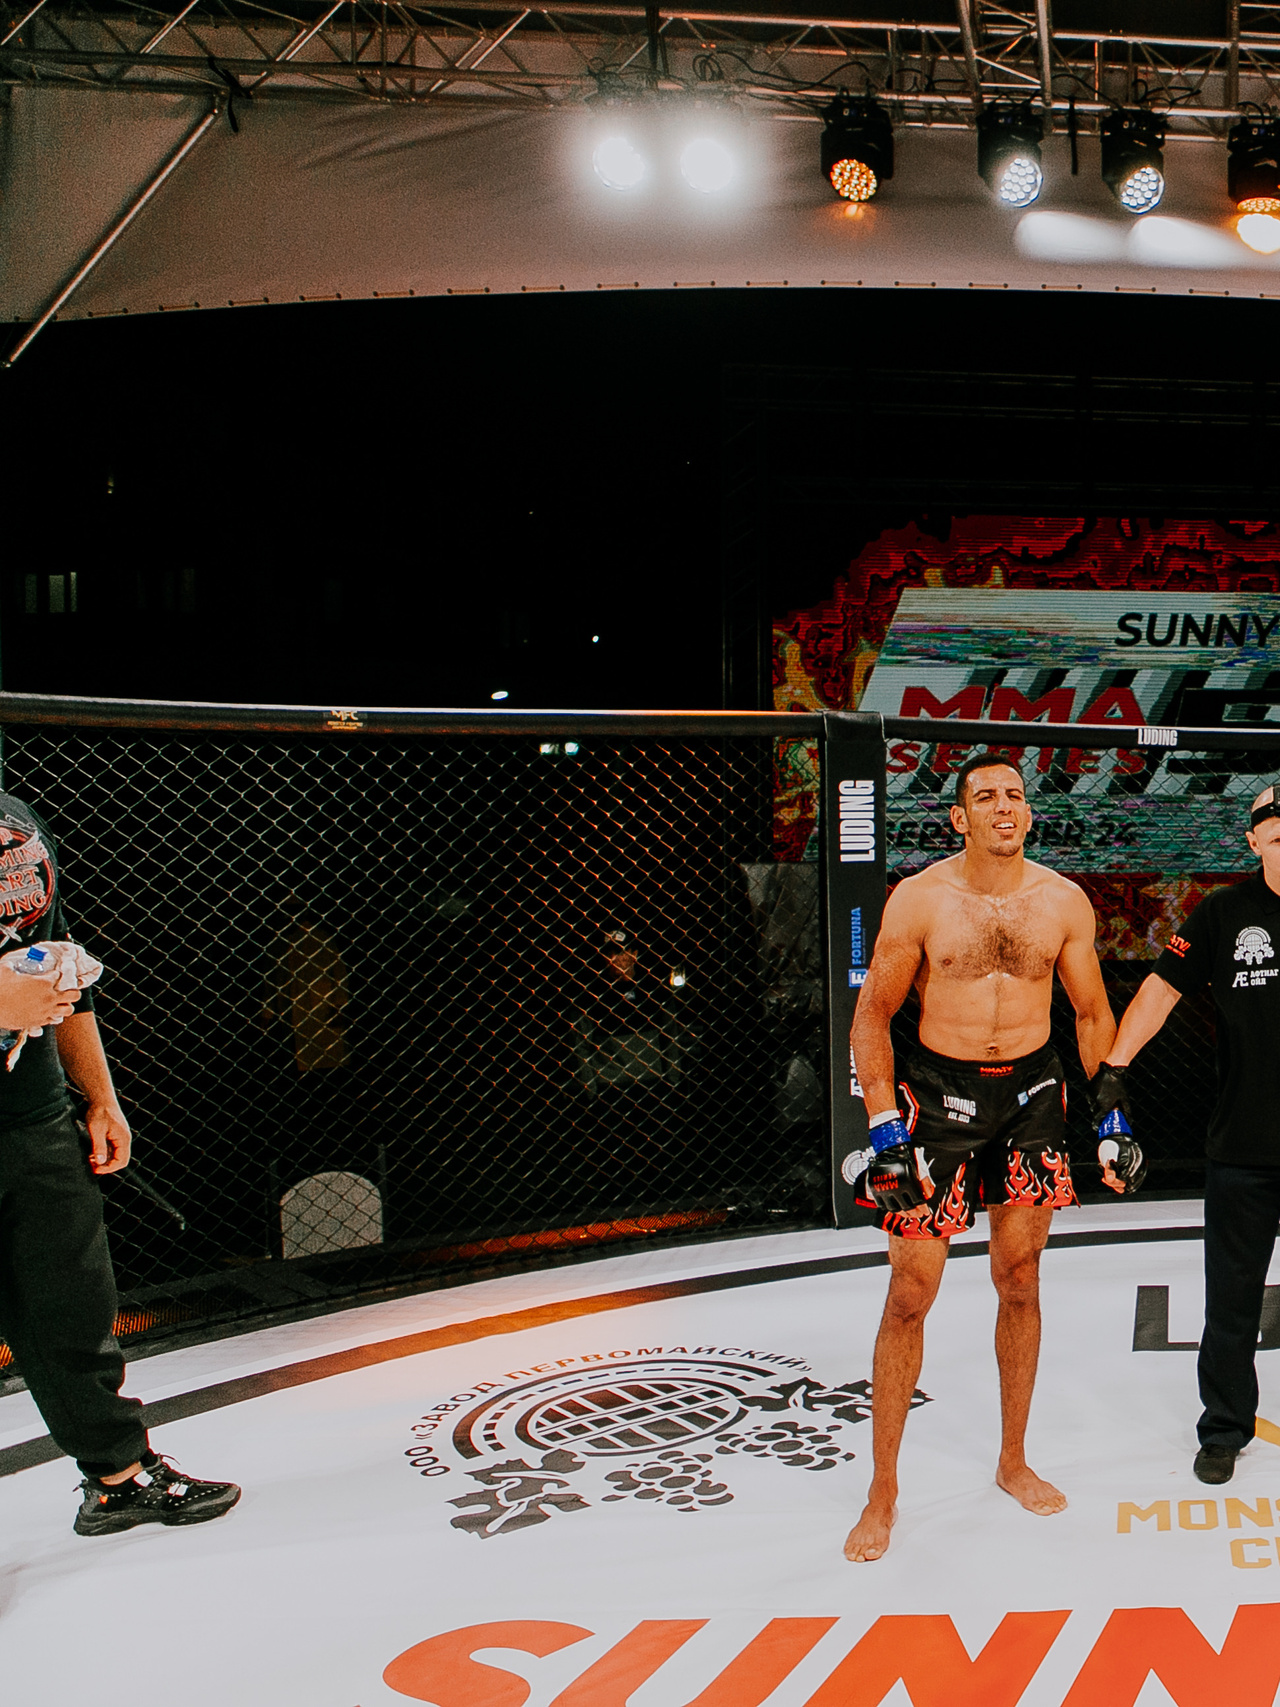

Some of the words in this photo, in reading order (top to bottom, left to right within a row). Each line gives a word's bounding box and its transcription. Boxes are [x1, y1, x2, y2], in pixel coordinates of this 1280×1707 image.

[1114, 612, 1280, 648] SUNNY
[899, 685, 1148, 726] MMA
[1137, 728, 1178, 746] LUDING
[838, 780, 876, 863] LUDING
[851, 907, 862, 965] FORTUNA
[943, 1095, 977, 1117] LUDING
[873, 1173, 898, 1183] SERIES
[873, 1180, 899, 1193] MMA
[503, 1344, 813, 1380] ПЕРВОМАЙСКИЙ»
[410, 1380, 505, 1441] «ЗАВОД
[404, 1446, 451, 1478] ООО
